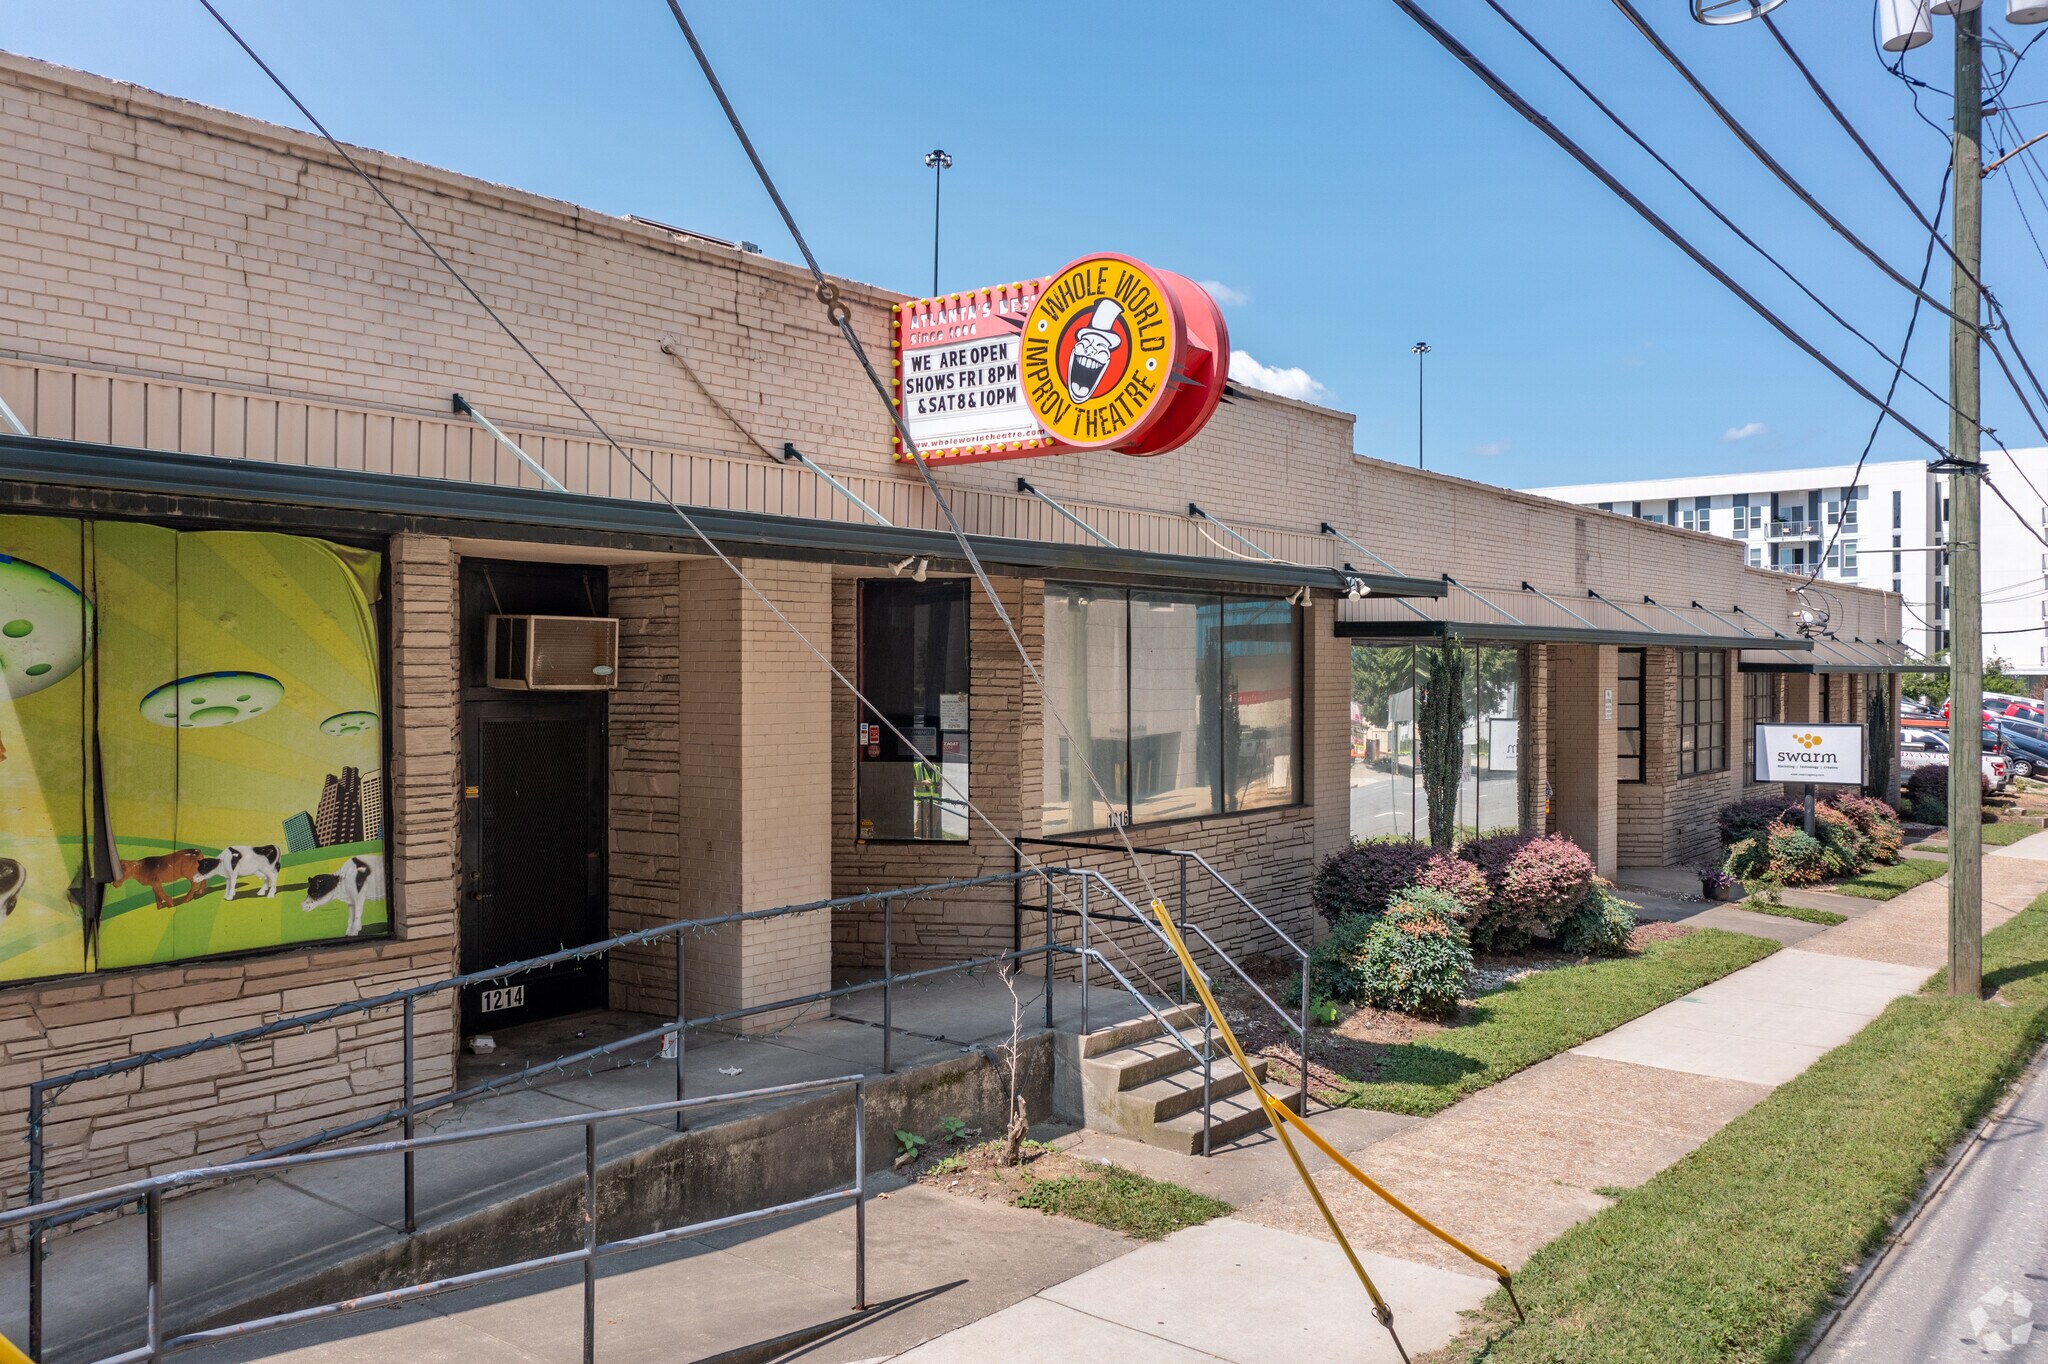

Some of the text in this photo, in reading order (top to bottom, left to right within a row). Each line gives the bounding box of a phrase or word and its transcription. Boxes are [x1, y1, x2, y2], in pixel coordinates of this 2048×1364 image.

[910, 302, 991, 330] ATLANTA'S
[1040, 267, 1165, 352] WHOLE WORLD
[910, 330, 944, 345] Since
[911, 343, 1008, 372] WE ARE OPEN
[906, 363, 1017, 394] SHOWS FRI 8PM
[1026, 338, 1157, 437] IMPROV THEATRE
[906, 428, 1046, 449] ww.wholeworldtheatre.com
[1777, 751, 1838, 763] swarm
[484, 986, 523, 1011] 1214
